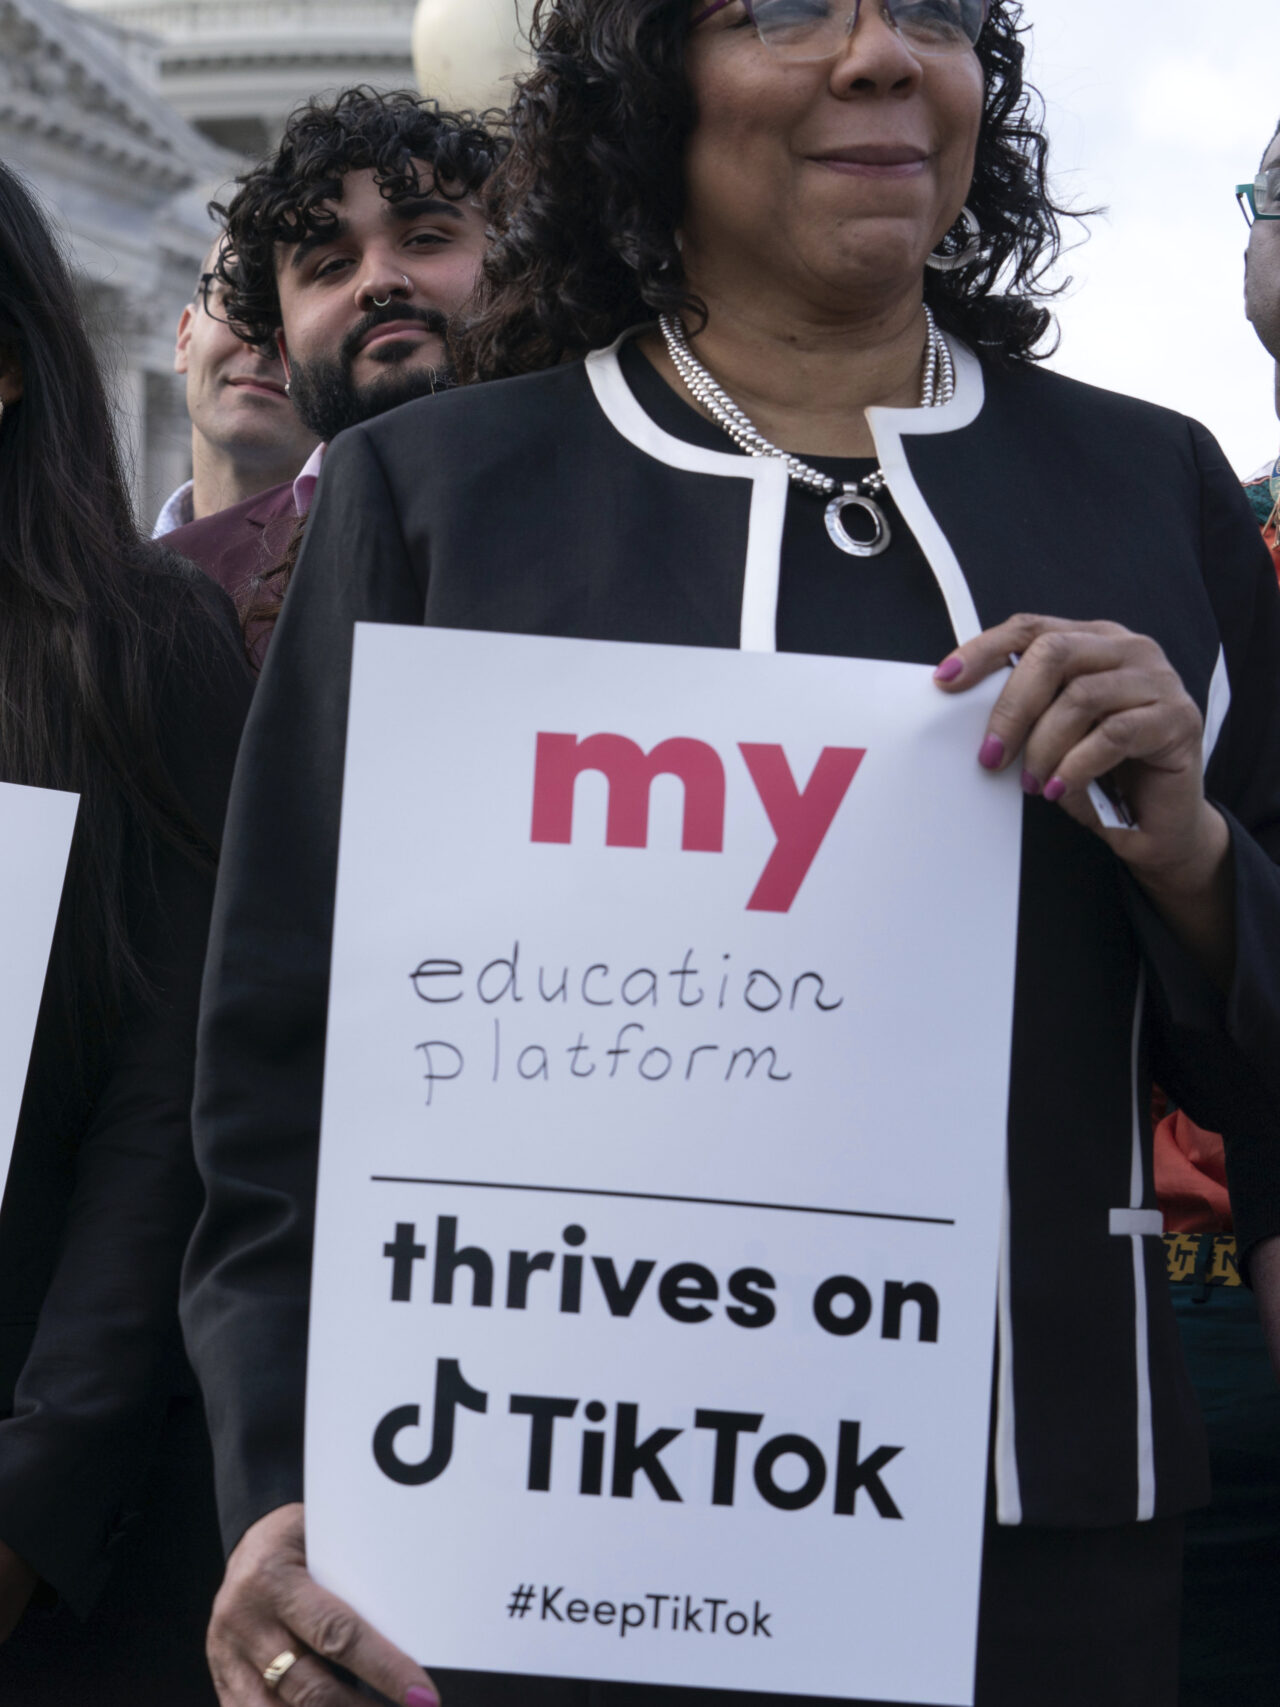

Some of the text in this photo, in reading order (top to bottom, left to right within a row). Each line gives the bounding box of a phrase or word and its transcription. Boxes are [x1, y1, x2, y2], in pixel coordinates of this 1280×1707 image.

[530, 731, 867, 914] my
[409, 941, 844, 1013] education
[412, 1019, 792, 1106] platform
[383, 1214, 940, 1343] thrives on
[509, 1394, 905, 1520] TikTok
[506, 1583, 773, 1639] #KeepTikTok
